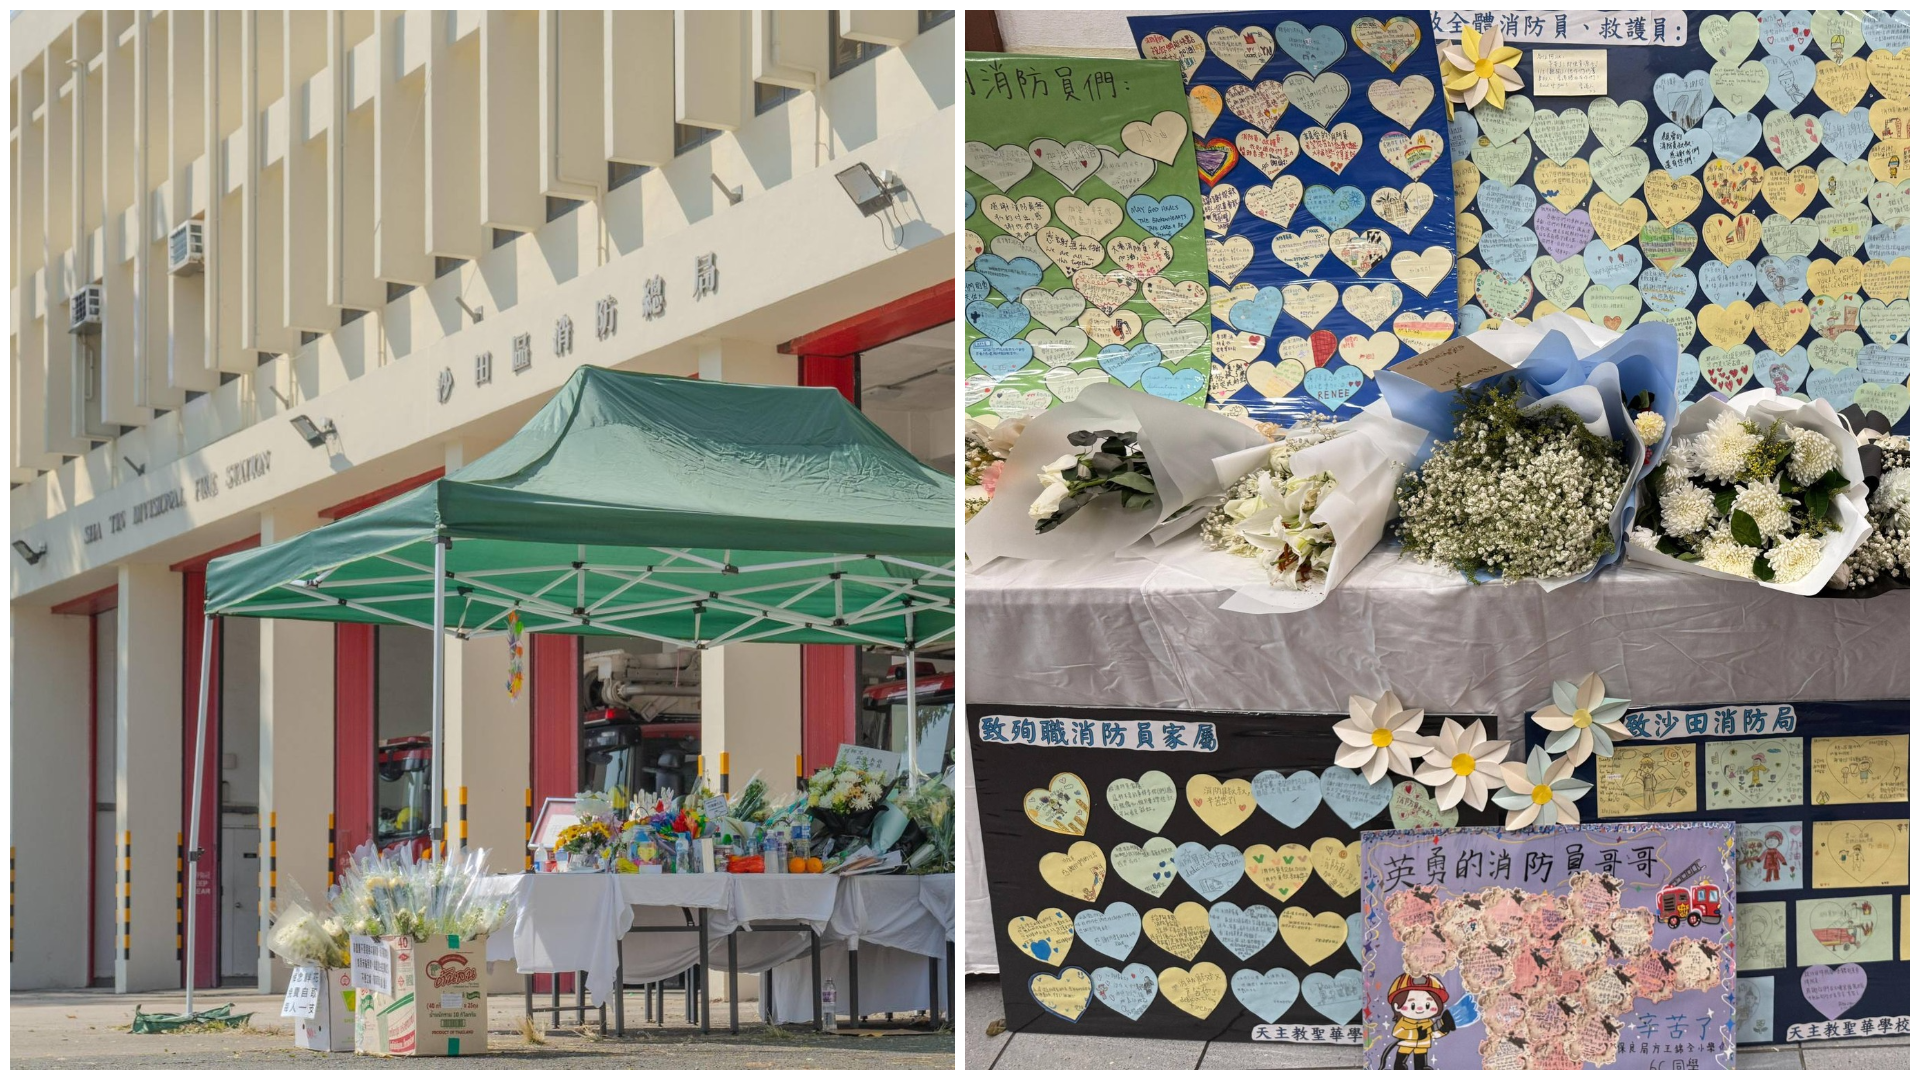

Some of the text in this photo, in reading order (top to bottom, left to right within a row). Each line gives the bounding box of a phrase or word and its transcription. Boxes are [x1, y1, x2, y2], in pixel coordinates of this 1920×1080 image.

[1661, 131, 1682, 141] 親愛的
[1130, 205, 1145, 214] MAY
[1147, 205, 1159, 213] GOD
[437, 251, 718, 404] 沙田區消防總局
[1318, 389, 1350, 400] RENEE
[84, 521, 103, 545] SHA
[225, 450, 272, 490] STATION
[1624, 706, 1797, 739] 致沙田消防局
[981, 717, 1217, 751] 致殉職消防員家屬
[1384, 844, 1658, 893] 英勇的消防員哥哥
[398, 937, 408, 949] 40
[1256, 1026, 1364, 1042] 天主教聖華學
[1636, 1013, 1713, 1040] 辛苦了
[1788, 1018, 1910, 1040] 天主教聖華學校
[1617, 1042, 1716, 1055] 保良局方王錦全小學
